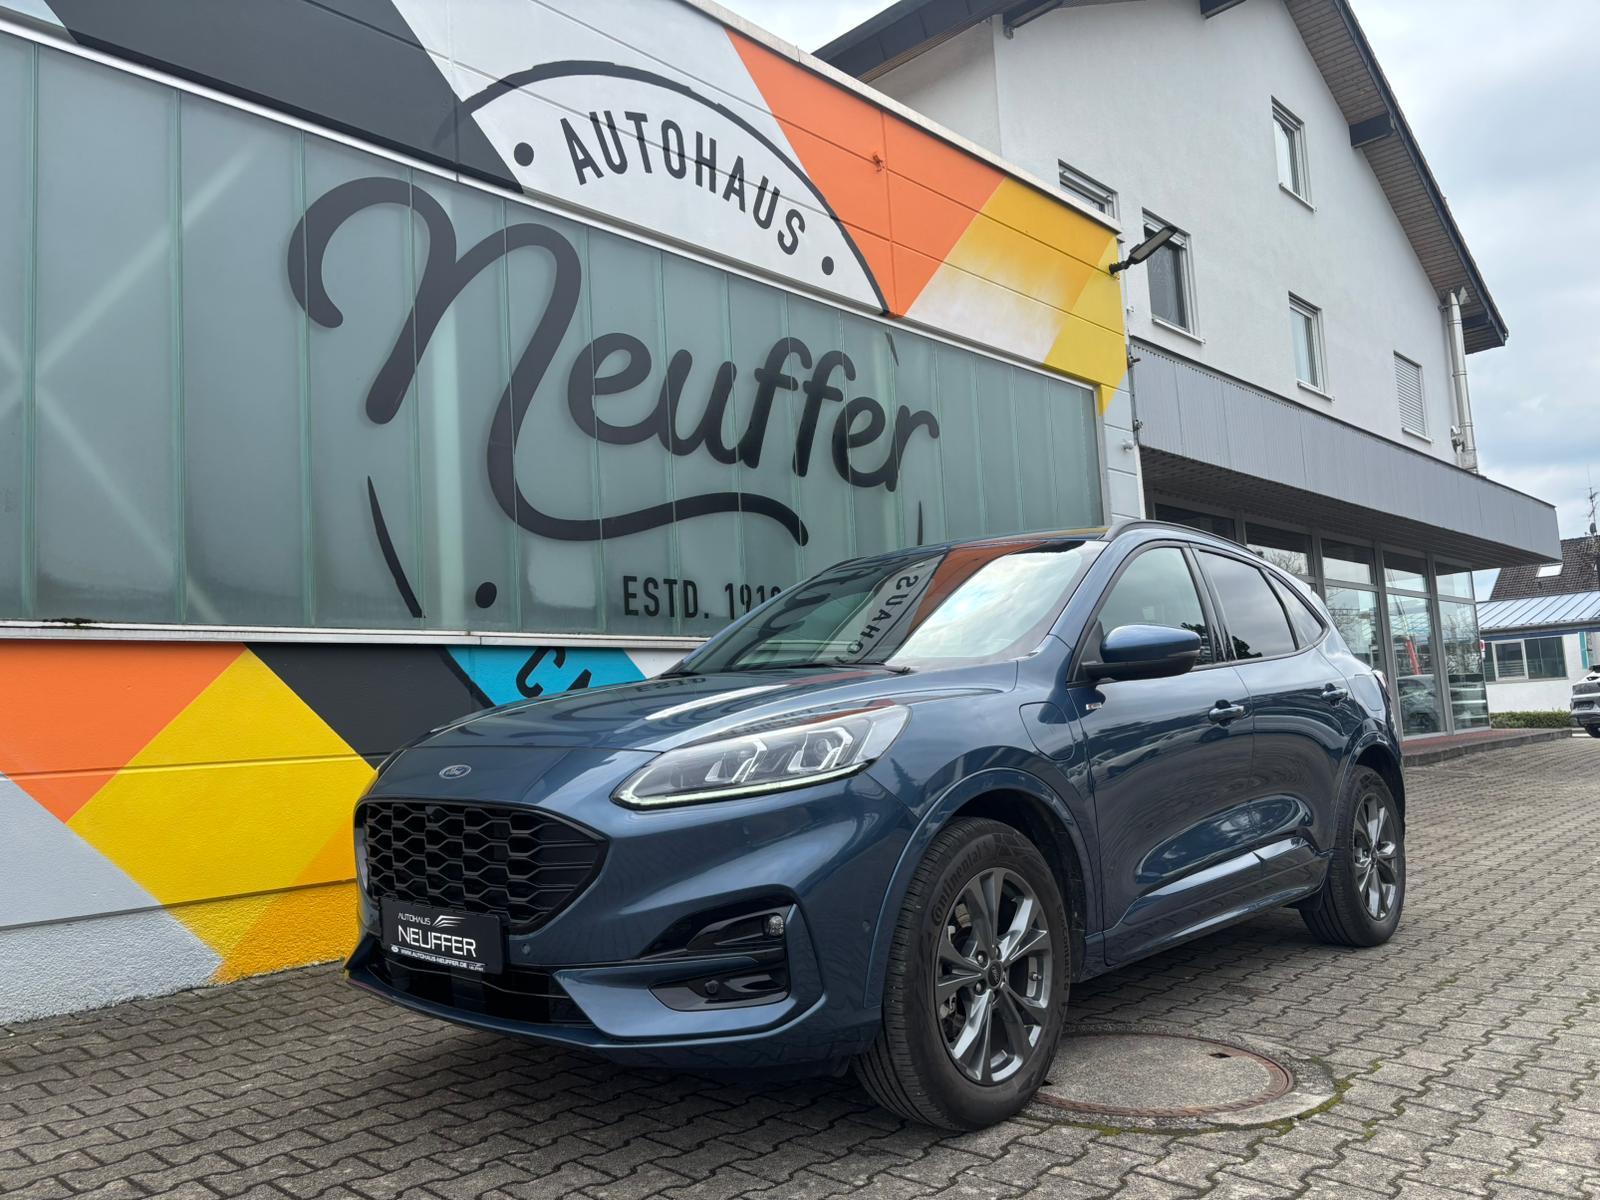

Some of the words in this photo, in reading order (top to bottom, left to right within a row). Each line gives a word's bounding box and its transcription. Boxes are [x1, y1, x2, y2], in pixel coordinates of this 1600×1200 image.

[560, 110, 806, 256] AUTOHAUS
[623, 576, 709, 620] ESTD.
[931, 844, 982, 926] Continental
[398, 912, 431, 925] AUTOHAUS
[398, 925, 477, 957] NEUFFER
